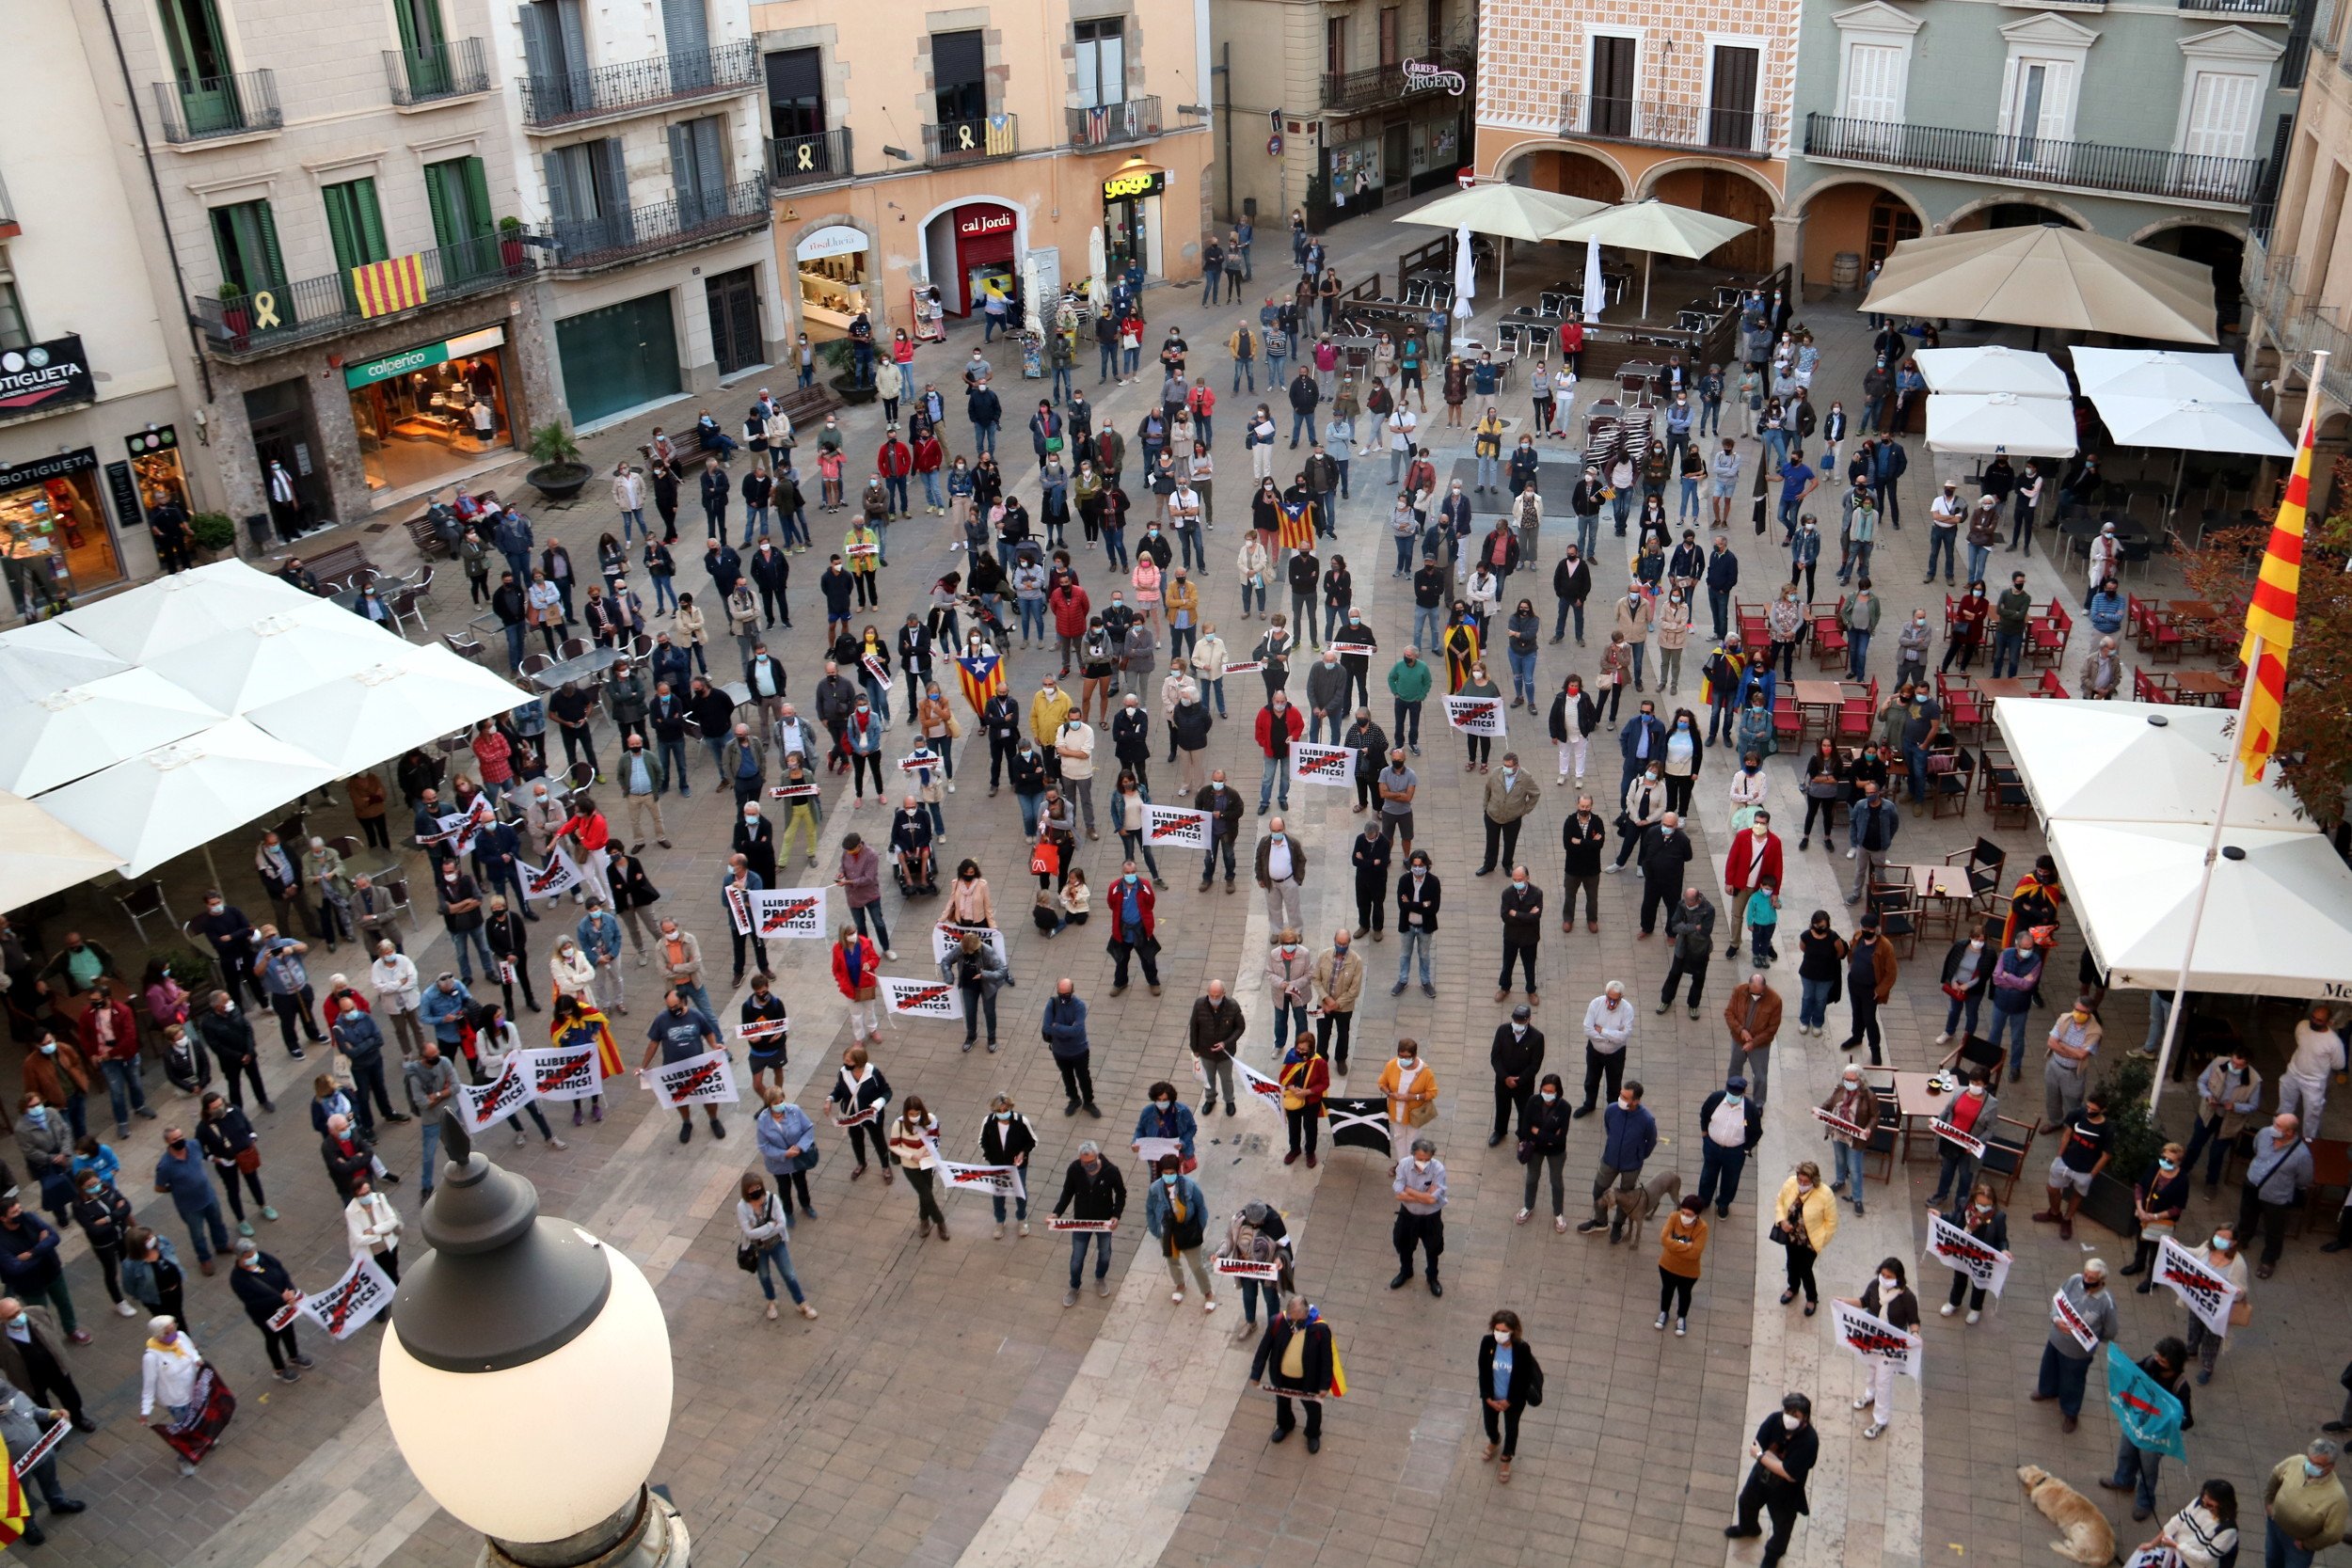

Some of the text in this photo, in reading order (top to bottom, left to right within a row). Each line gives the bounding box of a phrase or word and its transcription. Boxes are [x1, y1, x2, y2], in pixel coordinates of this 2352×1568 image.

[1403, 57, 1438, 77] CARRER
[1400, 71, 1459, 97] ARGENT
[1104, 174, 1152, 198] yoigo
[961, 214, 1010, 232] cal Jordi
[0, 363, 82, 390] TIGUETA
[368, 353, 425, 376] calperico
[0, 454, 93, 486] BOTIGUETA
